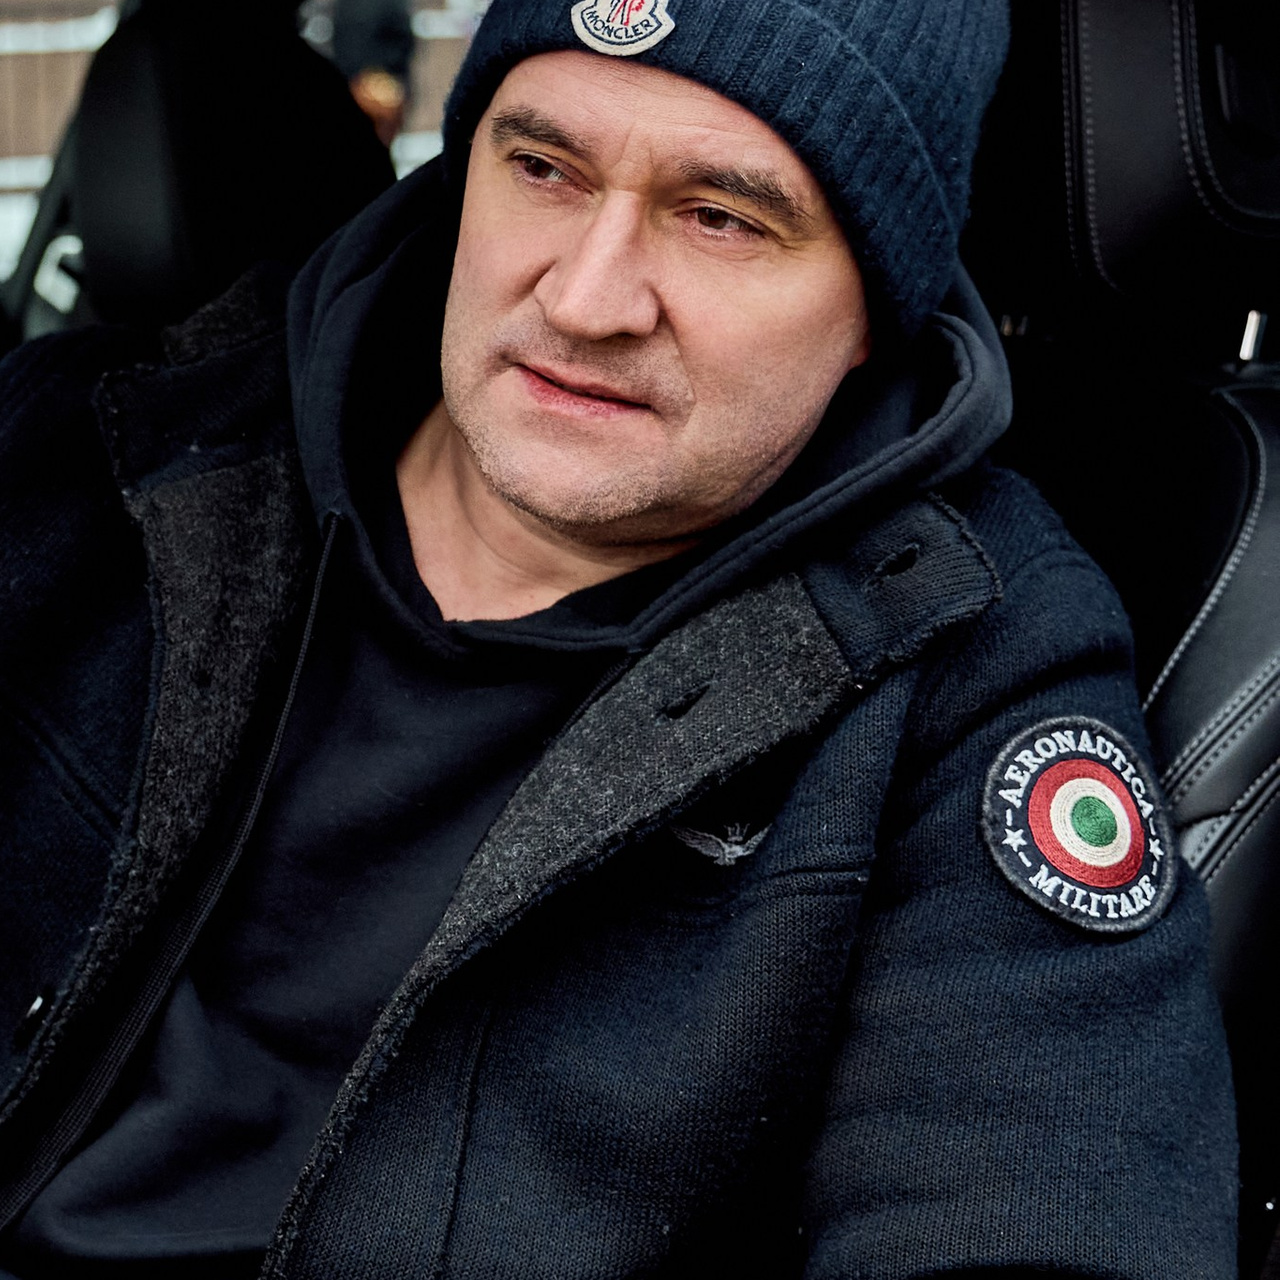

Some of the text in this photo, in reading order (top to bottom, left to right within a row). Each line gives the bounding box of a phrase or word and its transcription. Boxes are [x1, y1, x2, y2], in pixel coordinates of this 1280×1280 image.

[586, 10, 653, 39] MONCLER
[998, 729, 1155, 819] AERONAUTICA
[1028, 865, 1157, 919] MILITARE
